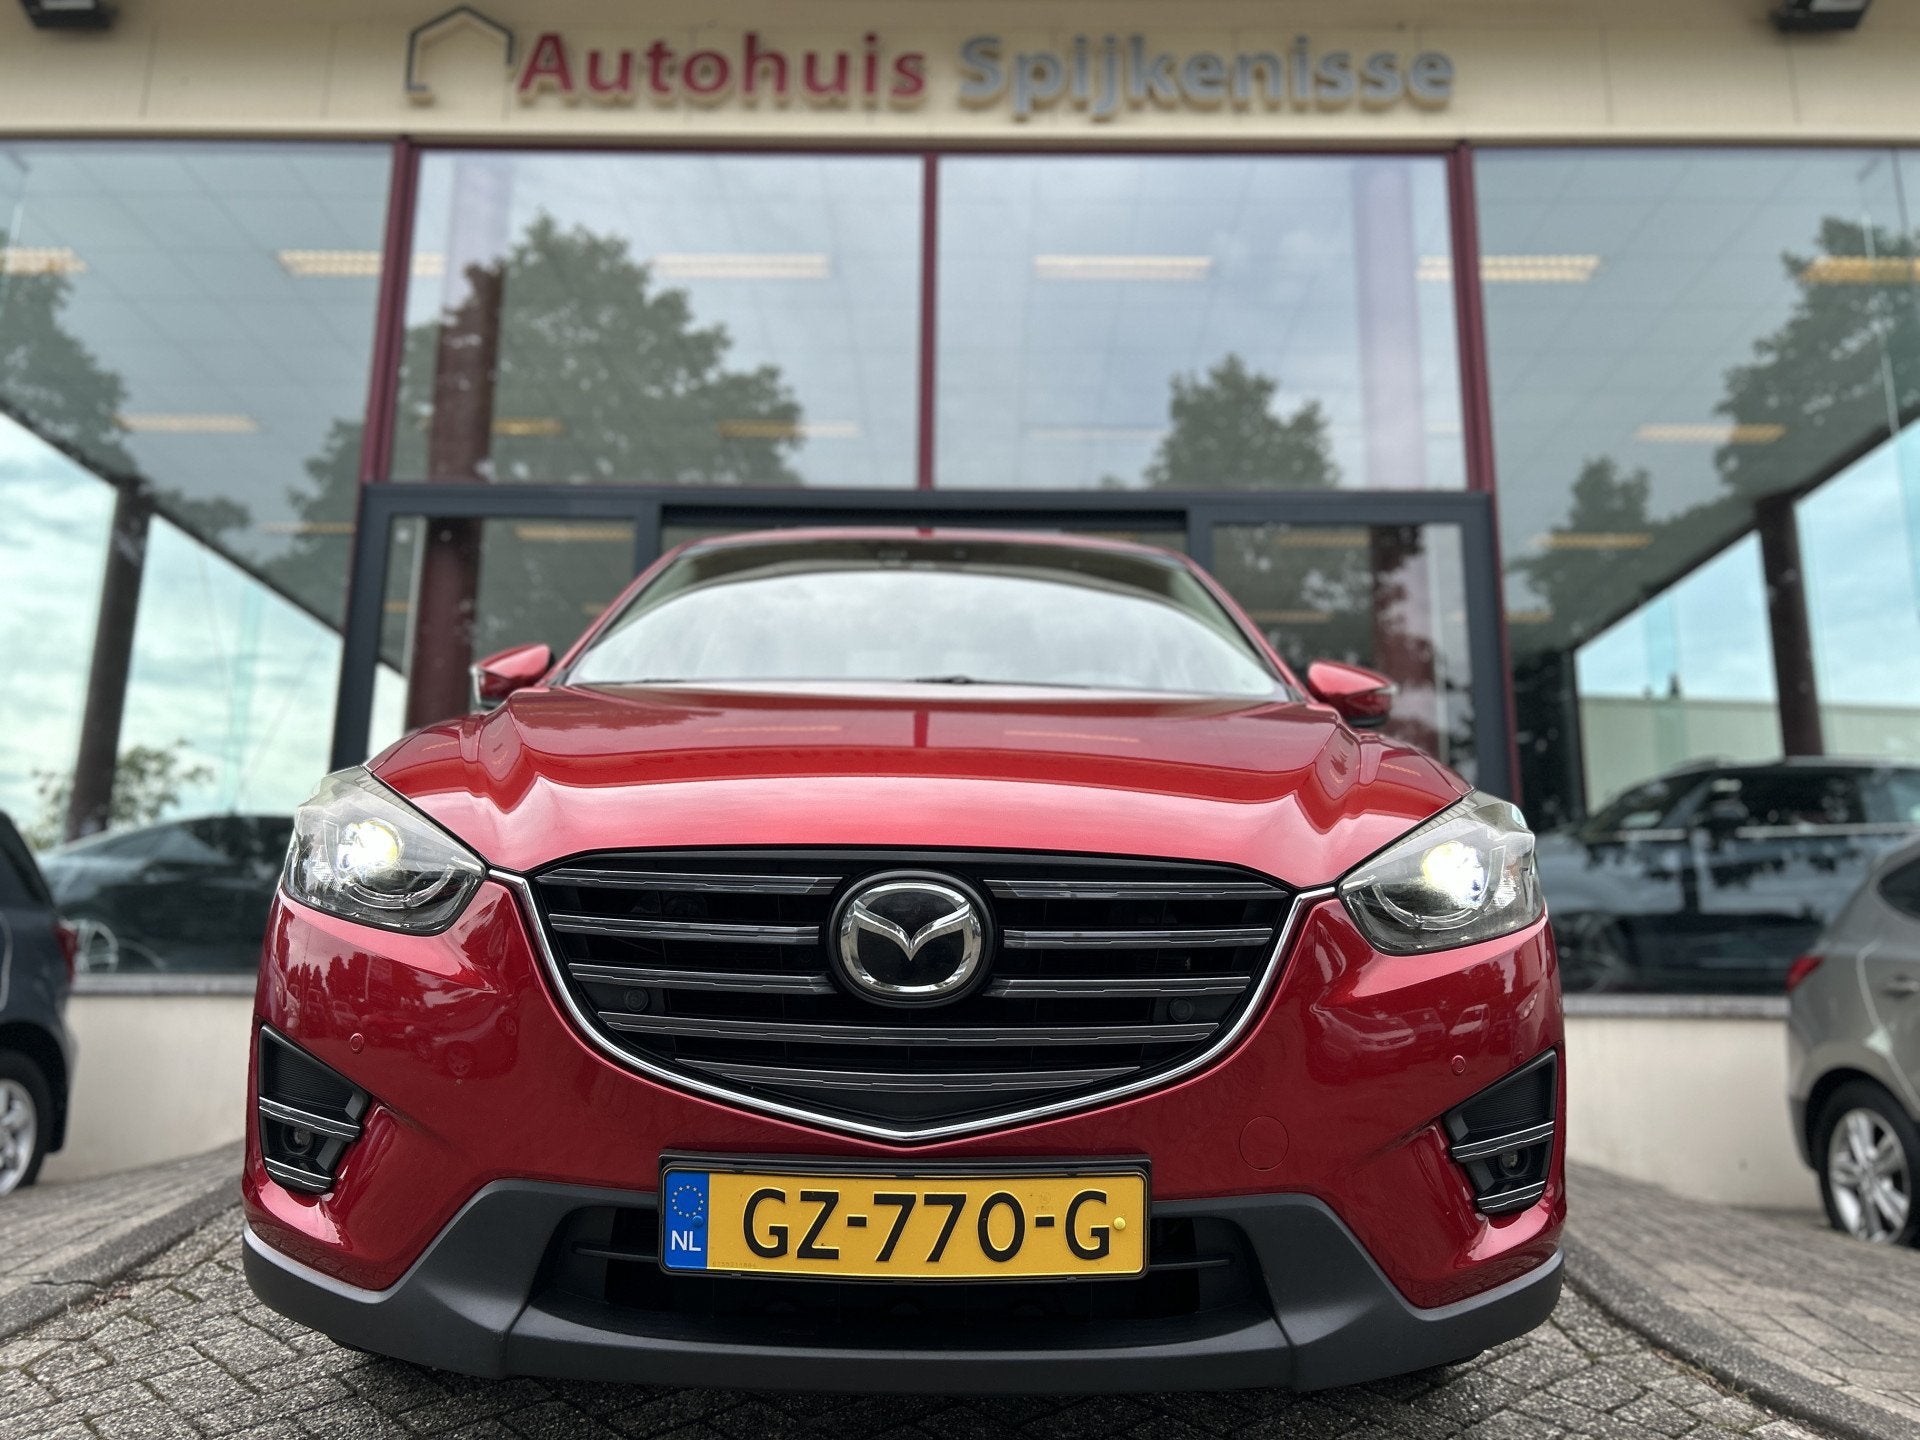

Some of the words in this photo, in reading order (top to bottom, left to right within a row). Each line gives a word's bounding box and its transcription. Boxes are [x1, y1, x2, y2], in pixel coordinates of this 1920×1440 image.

[518, 32, 927, 99] Autohuis
[959, 34, 1455, 118] Spijkenisse
[671, 1230, 702, 1252] NL
[742, 1187, 1111, 1263] GZ-770-G
